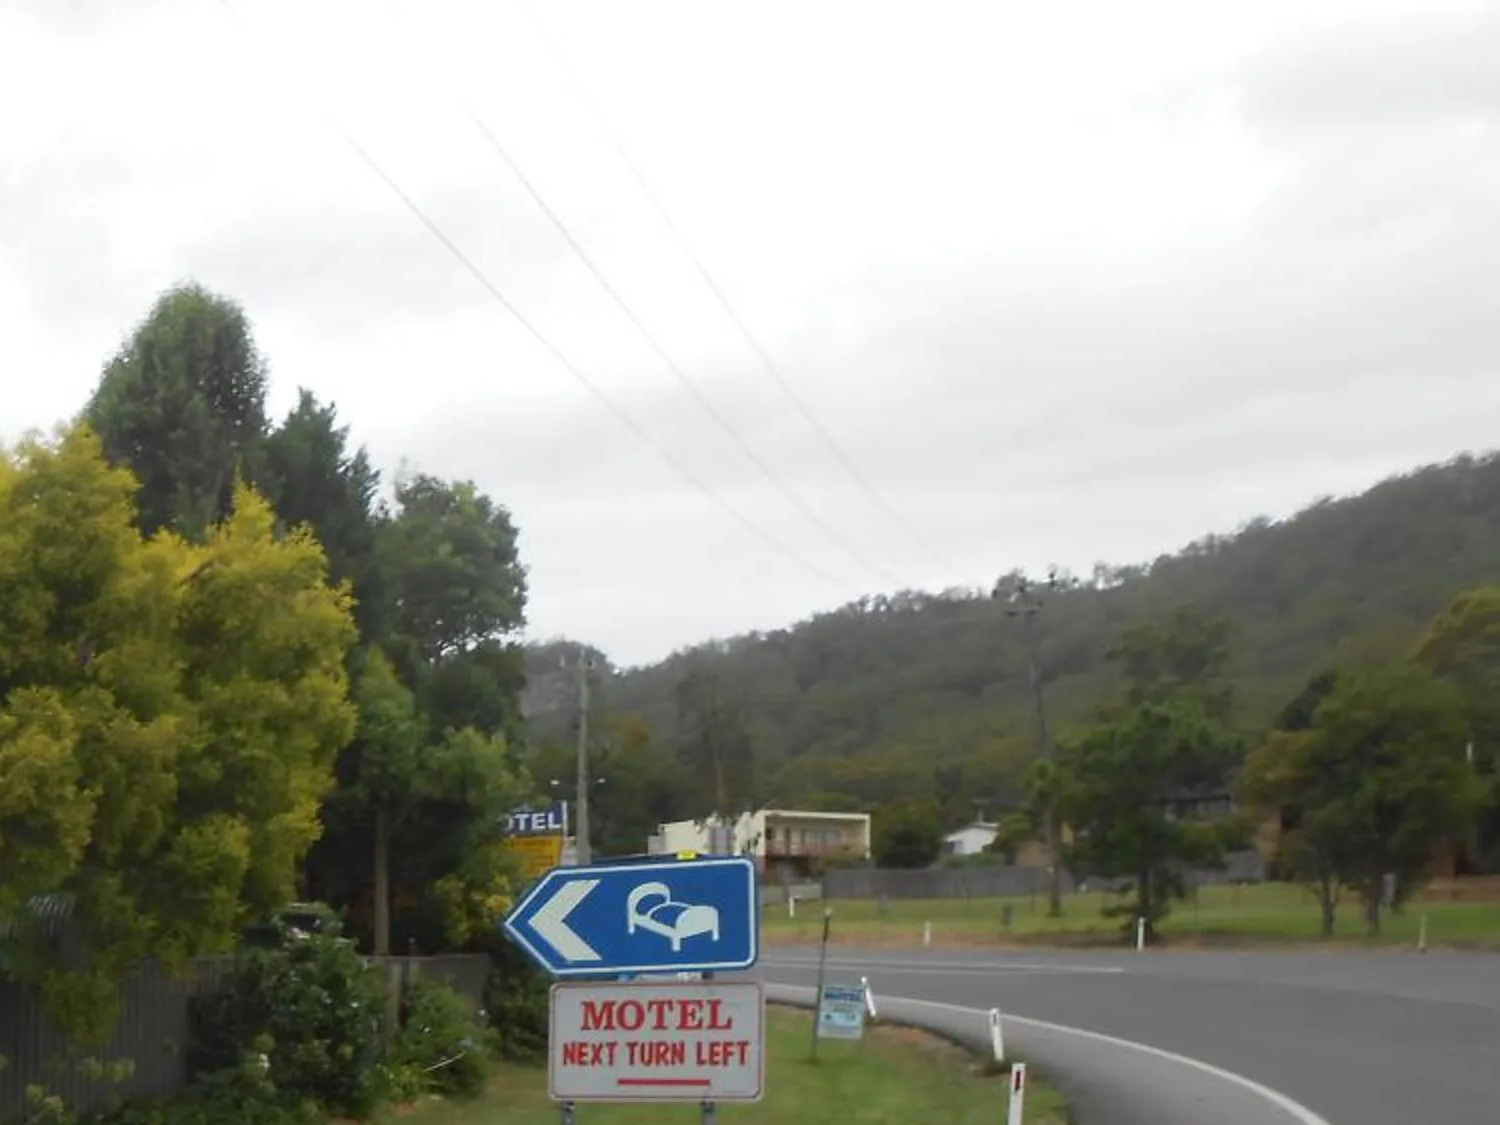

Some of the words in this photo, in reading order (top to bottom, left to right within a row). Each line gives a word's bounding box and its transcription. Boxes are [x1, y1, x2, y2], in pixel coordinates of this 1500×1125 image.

[501, 812, 561, 831] OTEL
[580, 1000, 732, 1031] MOTEL
[562, 1041, 618, 1067] NEXT
[626, 1041, 685, 1067] TURN
[696, 1040, 749, 1067] LEFT
